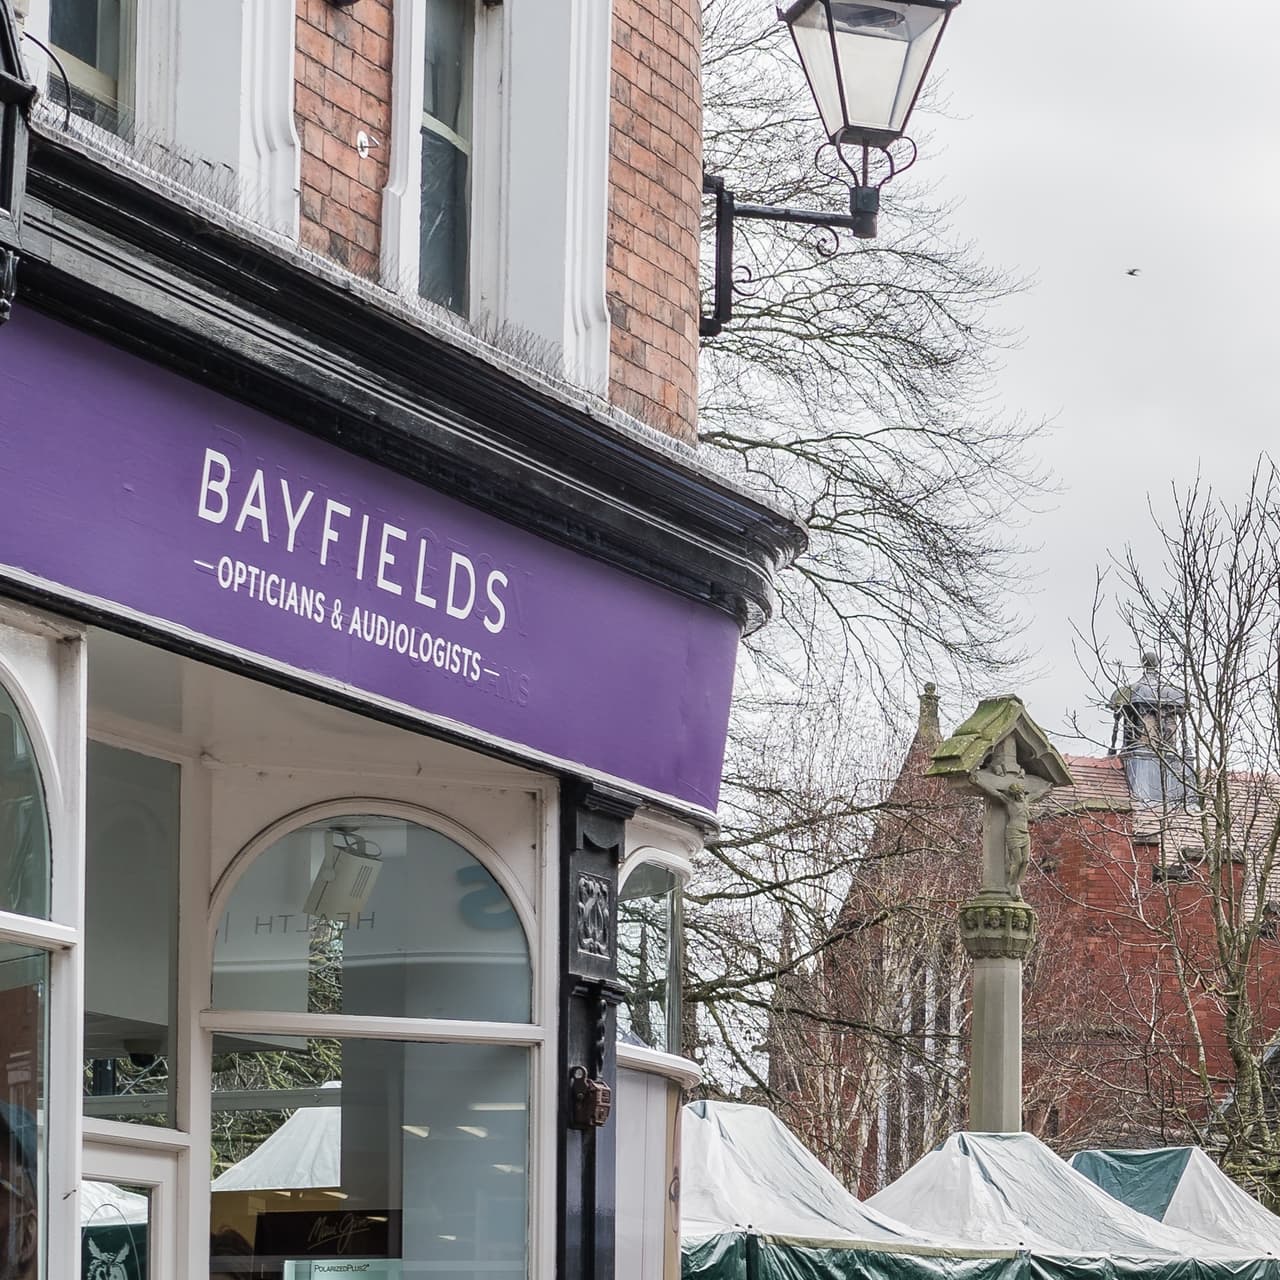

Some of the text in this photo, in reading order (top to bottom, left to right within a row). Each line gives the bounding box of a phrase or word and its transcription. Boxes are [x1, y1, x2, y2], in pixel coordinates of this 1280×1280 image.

[197, 447, 509, 635] BAYFIELDS
[217, 556, 482, 681] OPTICIANS & AUDIOLOGISTS
